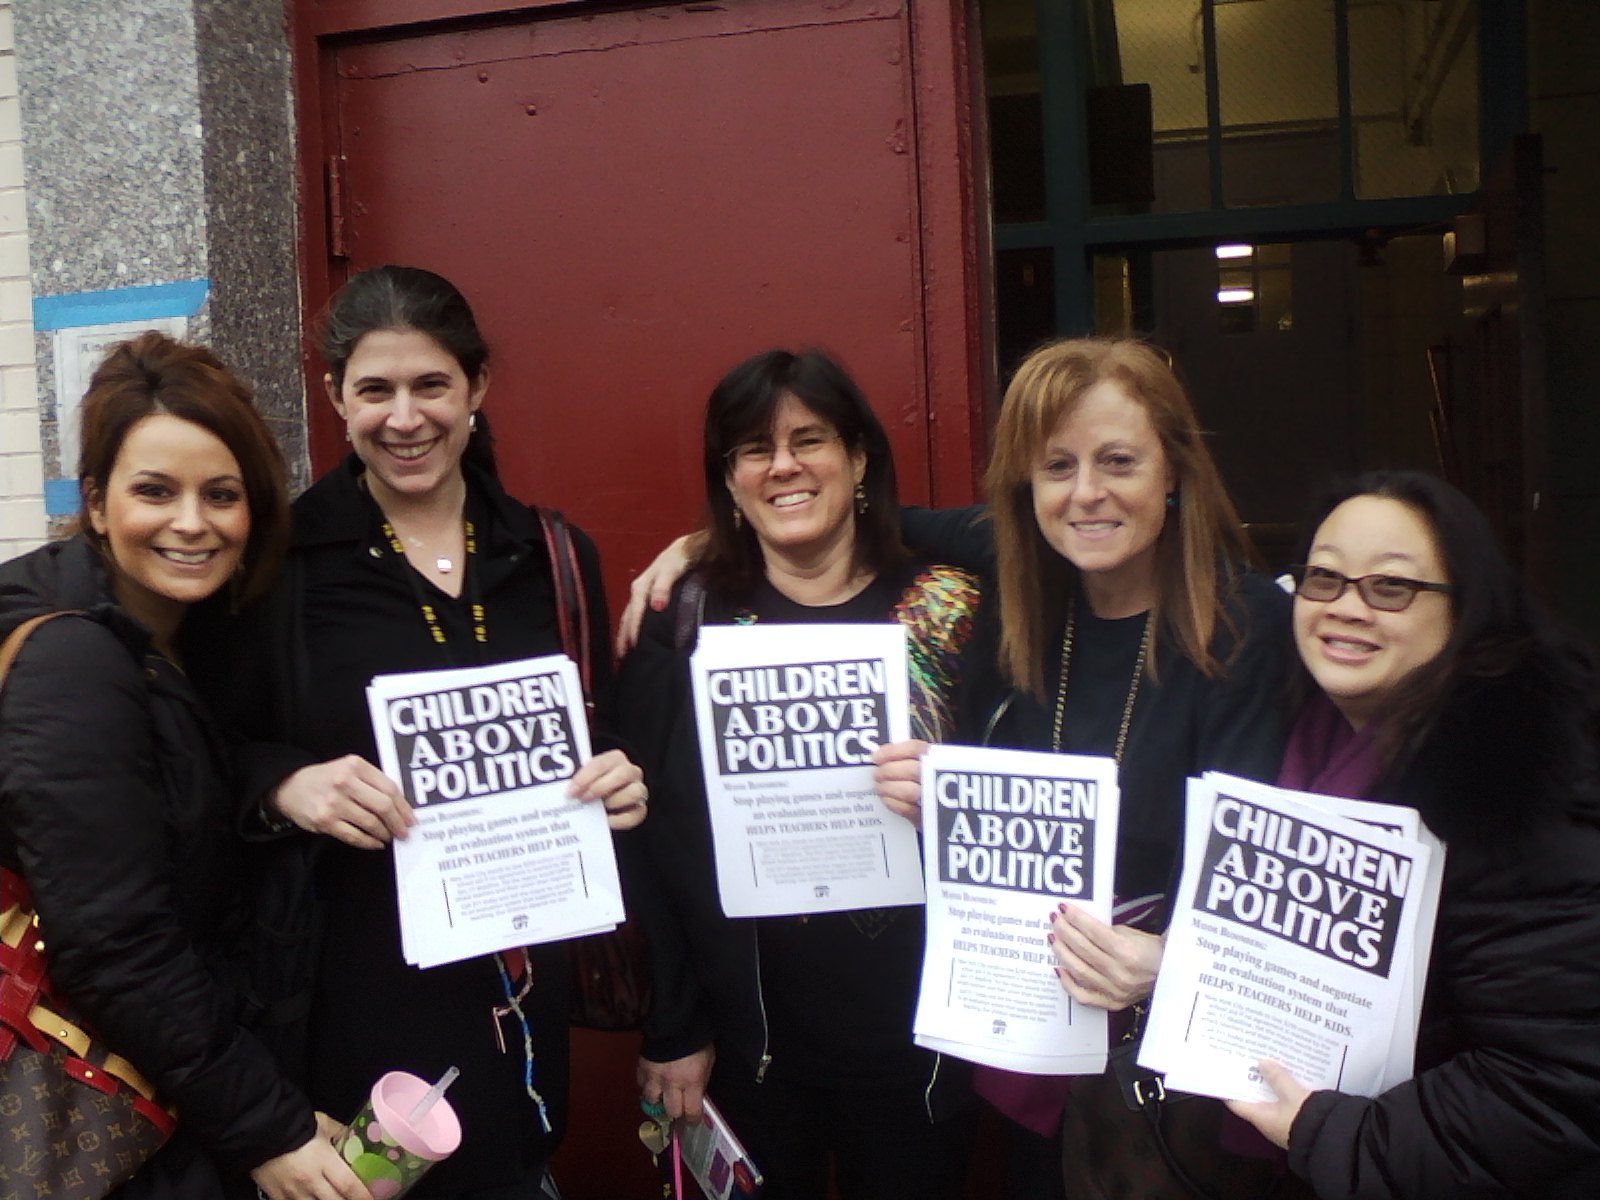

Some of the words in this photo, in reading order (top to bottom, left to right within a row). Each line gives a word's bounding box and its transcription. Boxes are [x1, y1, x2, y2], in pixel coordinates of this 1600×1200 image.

[390, 673, 568, 735] CHILDREN
[710, 661, 885, 705] CHILDREN
[408, 712, 567, 768] ABOVE
[724, 698, 878, 738] ABOVE
[724, 729, 880, 772] POLITICS
[411, 743, 575, 805] POLITICS
[825, 789, 843, 800] and
[936, 773, 1096, 820] CHILDREN
[422, 829, 446, 842] Stop
[447, 821, 486, 838] playing
[486, 815, 518, 830] games
[521, 809, 539, 822] and
[745, 824, 776, 836] HELPS
[779, 821, 829, 834] TEACHERS
[830, 819, 856, 830] HELP
[853, 802, 874, 813] that
[438, 858, 471, 872] HELPS
[474, 847, 526, 865] TEACHERS
[527, 840, 555, 855] HELP
[445, 843, 458, 854] an
[460, 833, 514, 851] evaluation
[515, 825, 549, 841] system
[549, 819, 570, 832] that
[947, 811, 1084, 857] ABOVE
[1212, 798, 1412, 898] CHILDREN
[949, 844, 1083, 895] POLITICS
[1214, 843, 1388, 930] ABOVE
[1025, 918, 1041, 929] and
[1206, 873, 1381, 969] POLITICS
[953, 939, 978, 953] HELPS
[980, 943, 1020, 960] TEACHERS
[1023, 951, 1045, 964] HELP
[1196, 936, 1220, 955] Stop
[1222, 946, 1263, 969] playing
[1264, 961, 1297, 980] games
[1299, 974, 1320, 990] and
[1321, 982, 1373, 1009] negotiate
[1198, 972, 1234, 992] HELPS
[1237, 983, 1292, 1013] TEACHERS
[1293, 1005, 1322, 1024] HELP
[1324, 1018, 1354, 1039] KIDS.
[1212, 960, 1227, 973] an
[1229, 965, 1286, 993] evaluation
[1287, 987, 1322, 1008] system
[1324, 999, 1348, 1018] that
